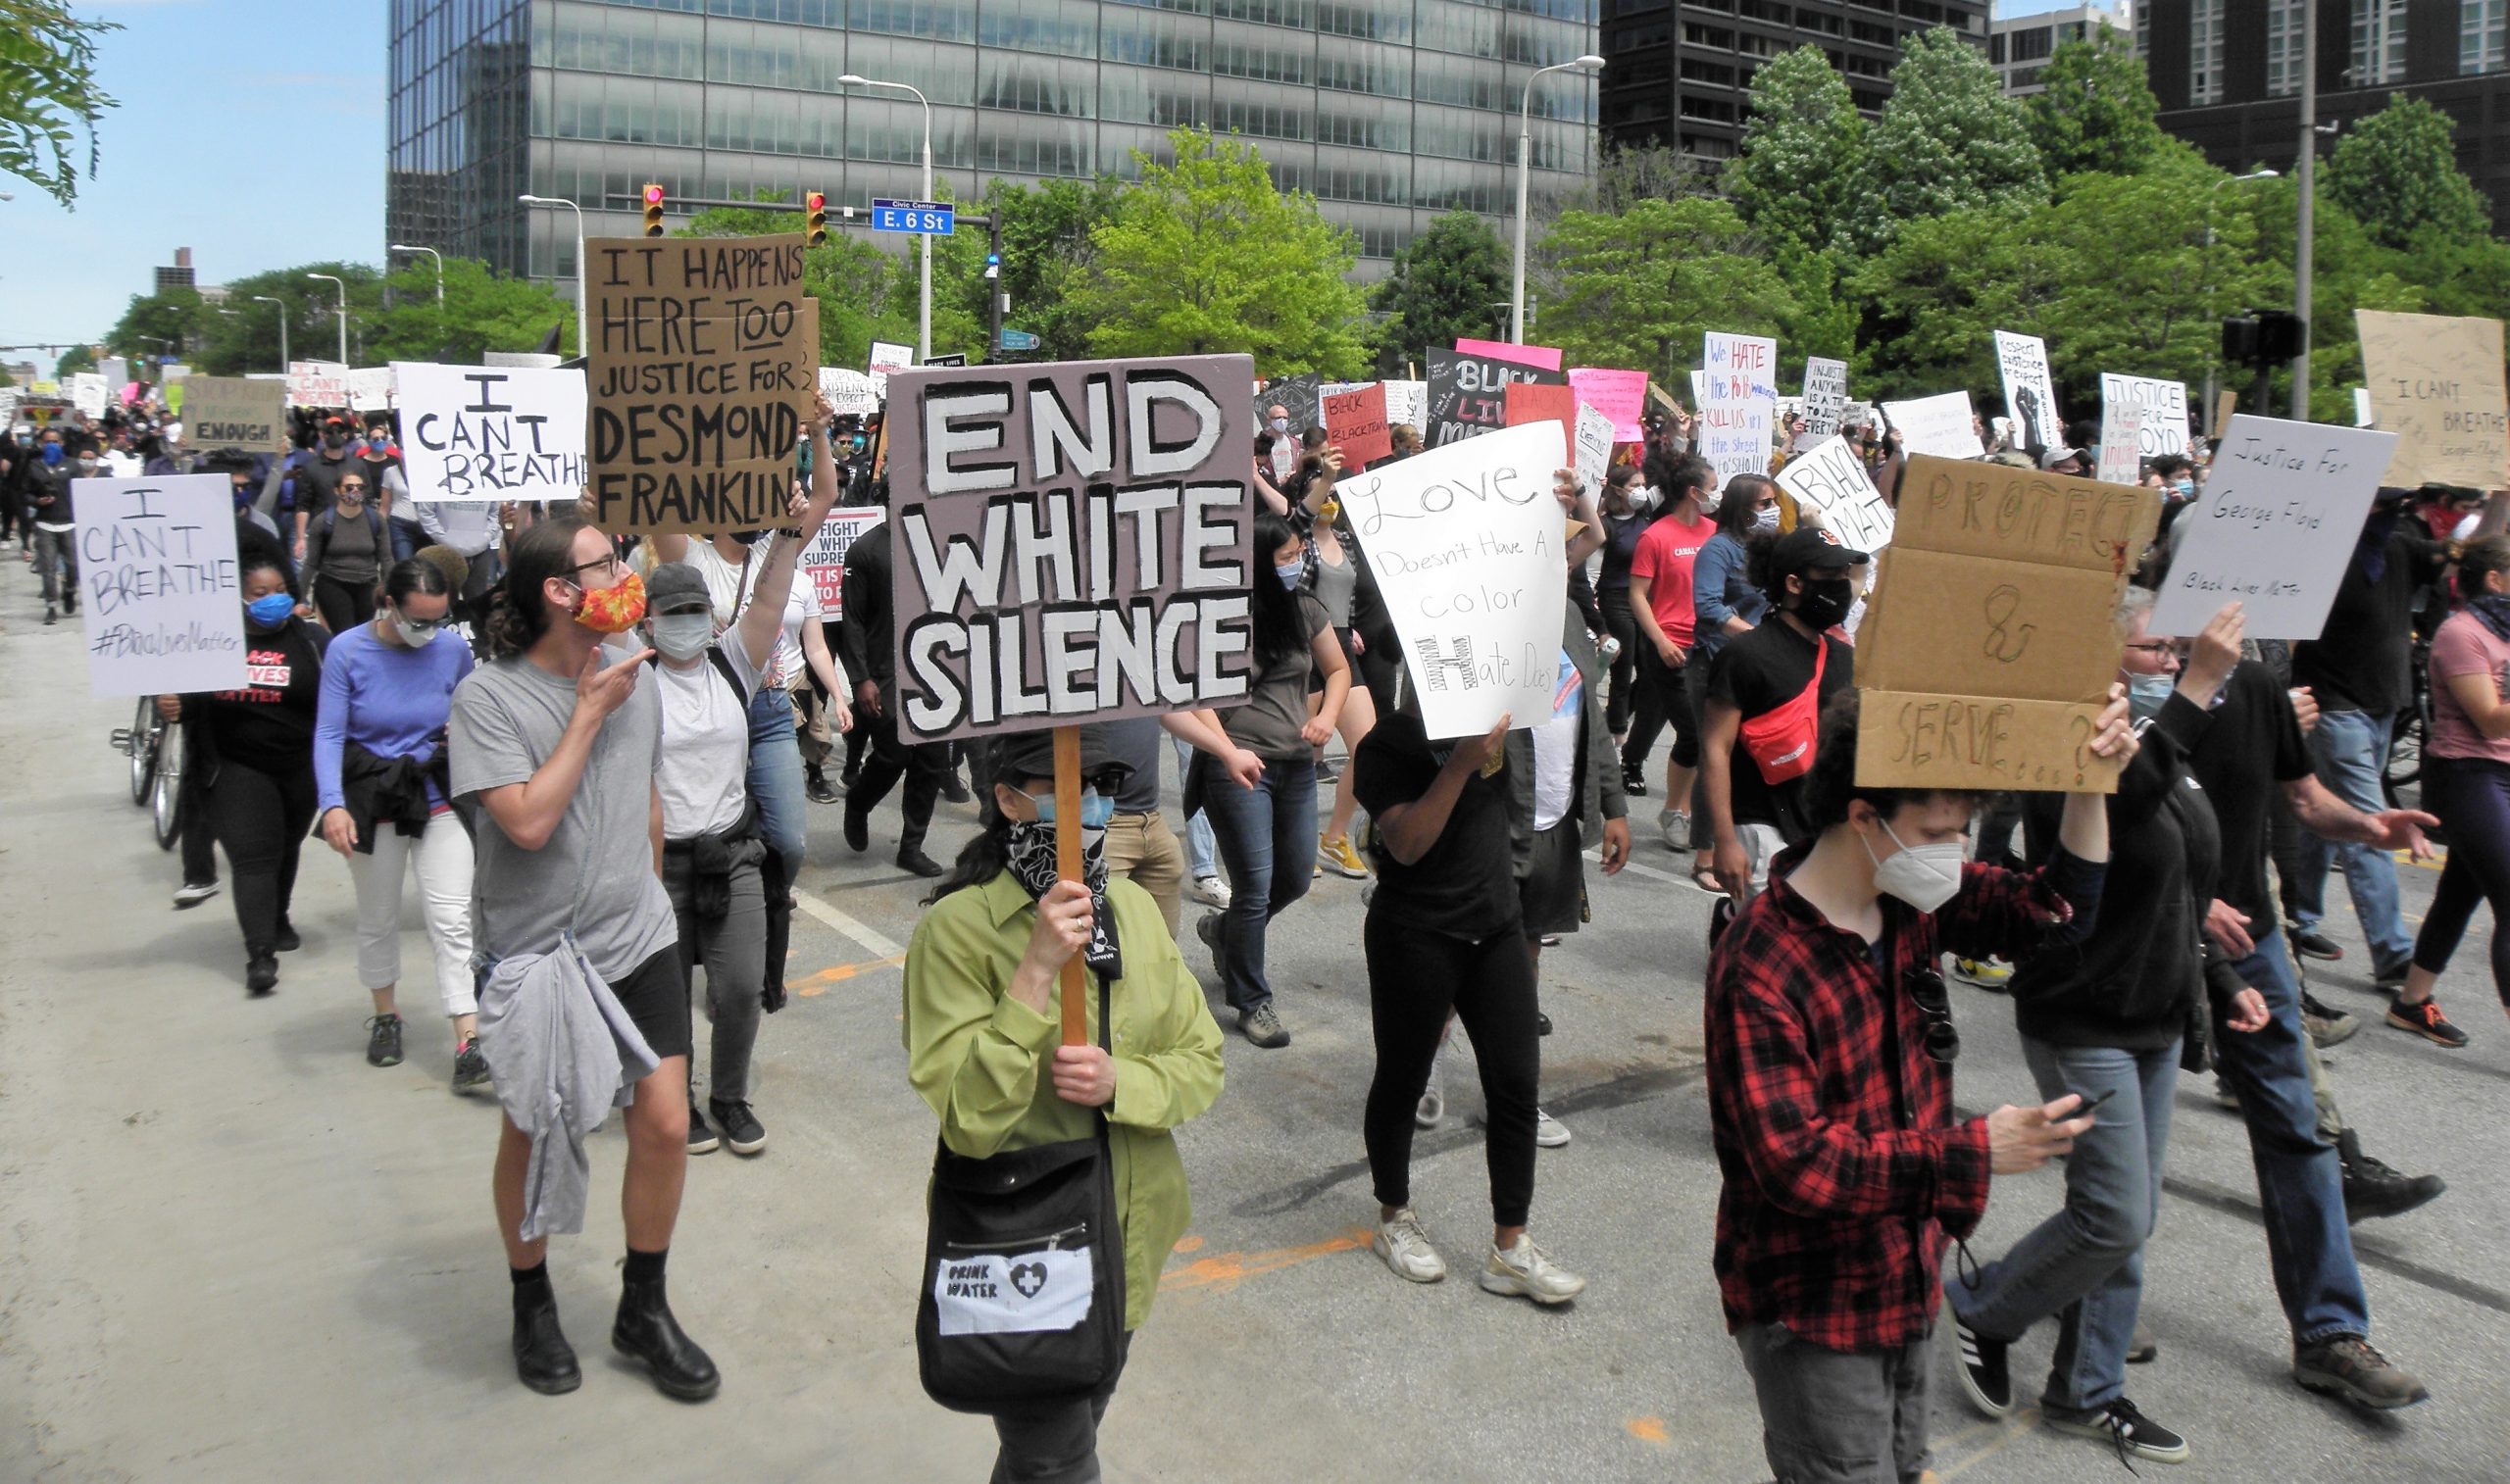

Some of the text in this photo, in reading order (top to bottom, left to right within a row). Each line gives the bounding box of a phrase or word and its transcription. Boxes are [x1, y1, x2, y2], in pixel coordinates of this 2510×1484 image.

[884, 212, 943, 230] E. 6 St
[602, 245, 803, 292] IT HAPPENS
[602, 296, 795, 355] HERE TOO
[1732, 341, 1766, 371] HATE
[599, 361, 738, 397] JUSTICE
[1455, 359, 1538, 393] BLACK
[1813, 365, 1843, 379] INJUST
[2004, 367, 2013, 376] or
[464, 373, 513, 413] I
[823, 381, 874, 394] XISTENCE
[835, 392, 867, 404] EXPECT
[1710, 375, 1729, 400] the
[1809, 393, 1818, 403] IS
[1821, 396, 1829, 405] A
[1810, 379, 1845, 394] ANYW
[2107, 378, 2181, 410] JUSTICE
[2416, 379, 2461, 404] CANT
[833, 403, 872, 415] SISTANCE
[1328, 394, 1363, 416] BLACK
[1457, 396, 1507, 424] LIV
[1807, 406, 1819, 417] TO
[1821, 407, 1839, 419] JUST
[2141, 409, 2163, 423] FOR
[197, 421, 272, 441] ENOUGH
[1706, 408, 1761, 429] KILL US in
[1804, 419, 1839, 435] EVERYW
[2443, 412, 2505, 433] BREATHE
[416, 411, 548, 454] CANT
[593, 402, 798, 468] DESMOND
[923, 368, 1223, 497] END
[1436, 421, 1498, 447] MAT
[2138, 427, 2182, 456] OYD
[1711, 436, 1729, 455] the
[2234, 437, 2350, 473] Justice For
[1790, 444, 1870, 510] BLACK
[121, 488, 167, 519] I
[597, 468, 794, 527] FRANKLIN
[1349, 462, 1538, 537] Love
[1922, 472, 2139, 559] PROTECT
[2213, 489, 2326, 533] George Floyd
[820, 521, 860, 537] FIGHT
[83, 524, 202, 563] CANT
[819, 536, 857, 551] WHIT
[901, 479, 1246, 614] WHITE
[1479, 529, 1524, 557] Have
[1534, 530, 1548, 558] A
[804, 551, 843, 565] SUPRE
[90, 560, 236, 616] BREATHE
[826, 569, 838, 582] IS
[2183, 571, 2224, 591] Black
[1983, 583, 2037, 664] &
[246, 649, 285, 666] ACK
[899, 587, 1251, 737] SILENCE
[1414, 635, 1552, 692] Hate Does
[246, 668, 290, 684] IVES
[948, 1264, 989, 1280] DRINK
[946, 1283, 998, 1299] WATER
